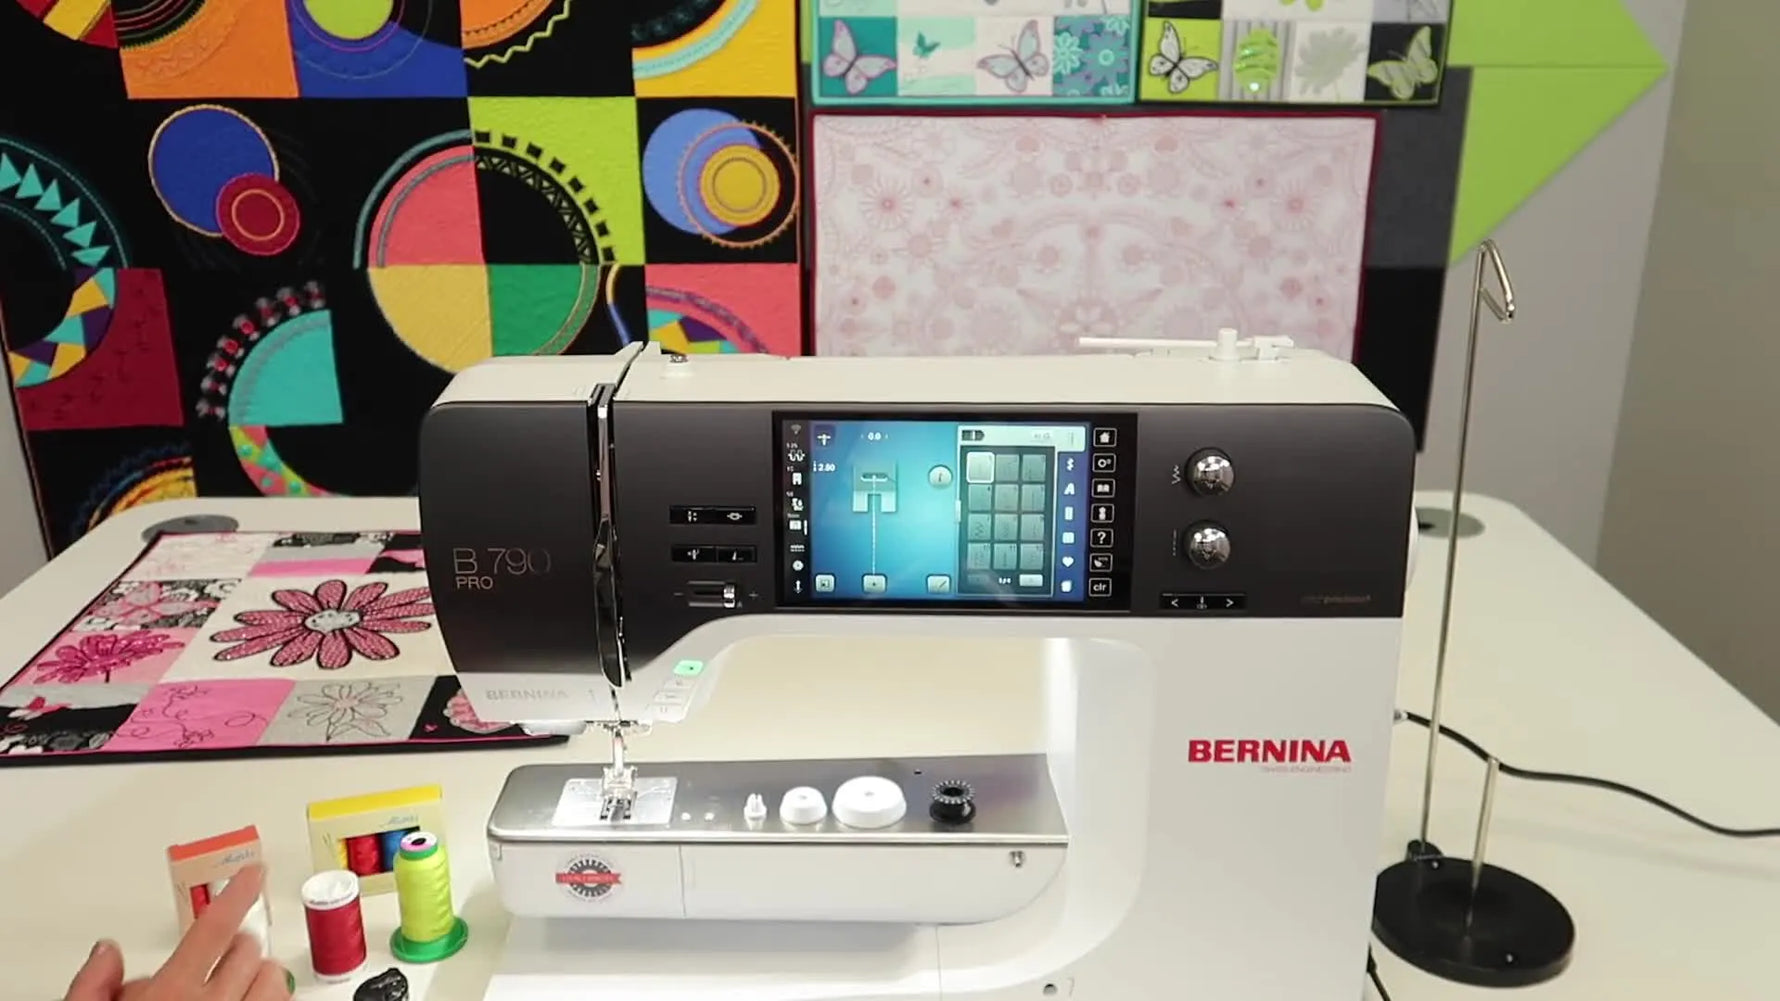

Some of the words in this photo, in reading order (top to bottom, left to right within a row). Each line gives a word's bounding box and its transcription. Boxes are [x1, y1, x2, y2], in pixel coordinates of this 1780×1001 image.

[453, 547, 478, 575] B
[487, 547, 552, 576] 790
[455, 576, 494, 590] PRO
[1092, 582, 1108, 592] clr
[1187, 739, 1352, 763] BERNINA
